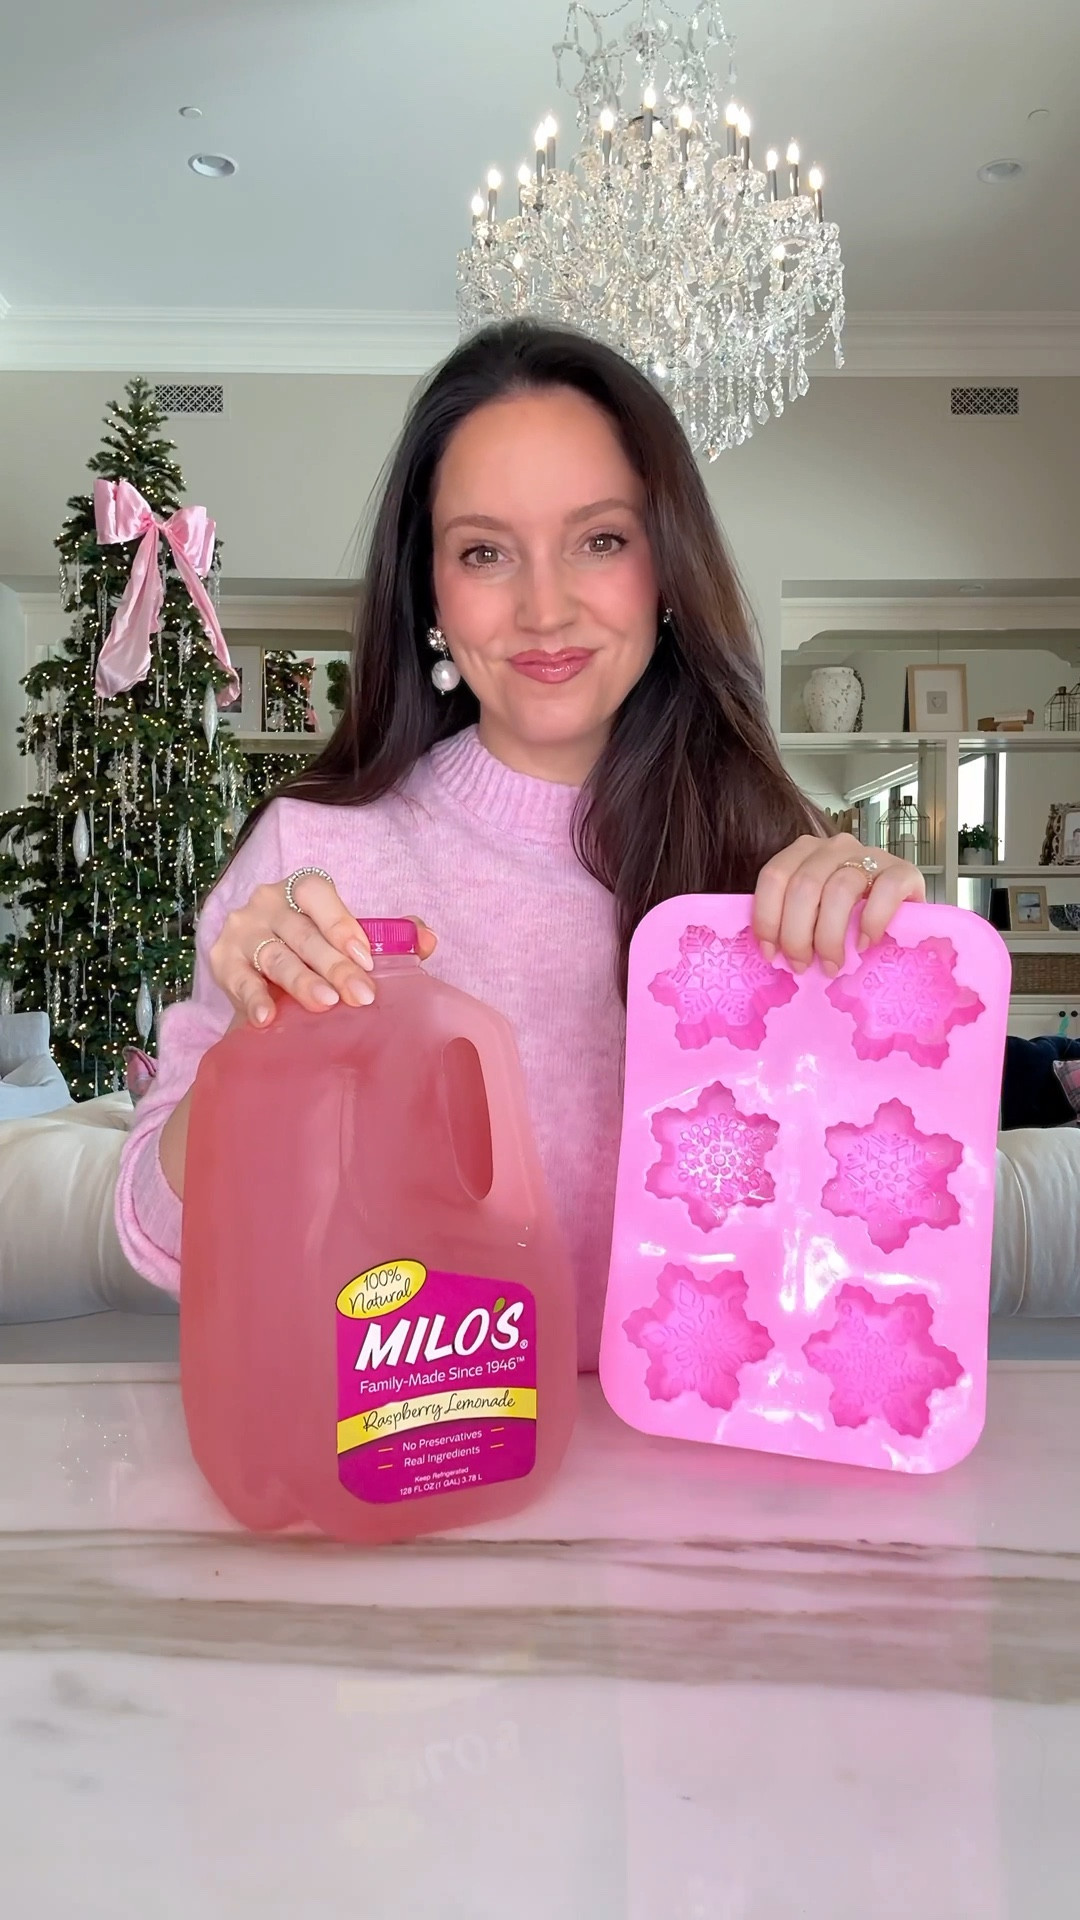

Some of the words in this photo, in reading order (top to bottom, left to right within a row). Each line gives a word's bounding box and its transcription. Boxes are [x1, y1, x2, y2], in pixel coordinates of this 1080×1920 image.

[363, 1265, 402, 1292] 100%
[349, 1277, 412, 1315] Natural
[360, 1370, 446, 1394] Family-Made
[448, 1363, 483, 1381] Since
[362, 1401, 443, 1432] Raspberry
[443, 1389, 516, 1415] Lemonade
[402, 1441, 417, 1452] No
[418, 1430, 483, 1449] Preservatives
[403, 1455, 425, 1467] Real
[427, 1446, 481, 1464] Ingredients
[399, 1486, 412, 1496] 128
[413, 1484, 423, 1493] FL
[461, 1475, 477, 1484] 3.78
[477, 1473, 483, 1481] L
[414, 1474, 431, 1483] Keep
[432, 1466, 469, 1480] Refrigerated
